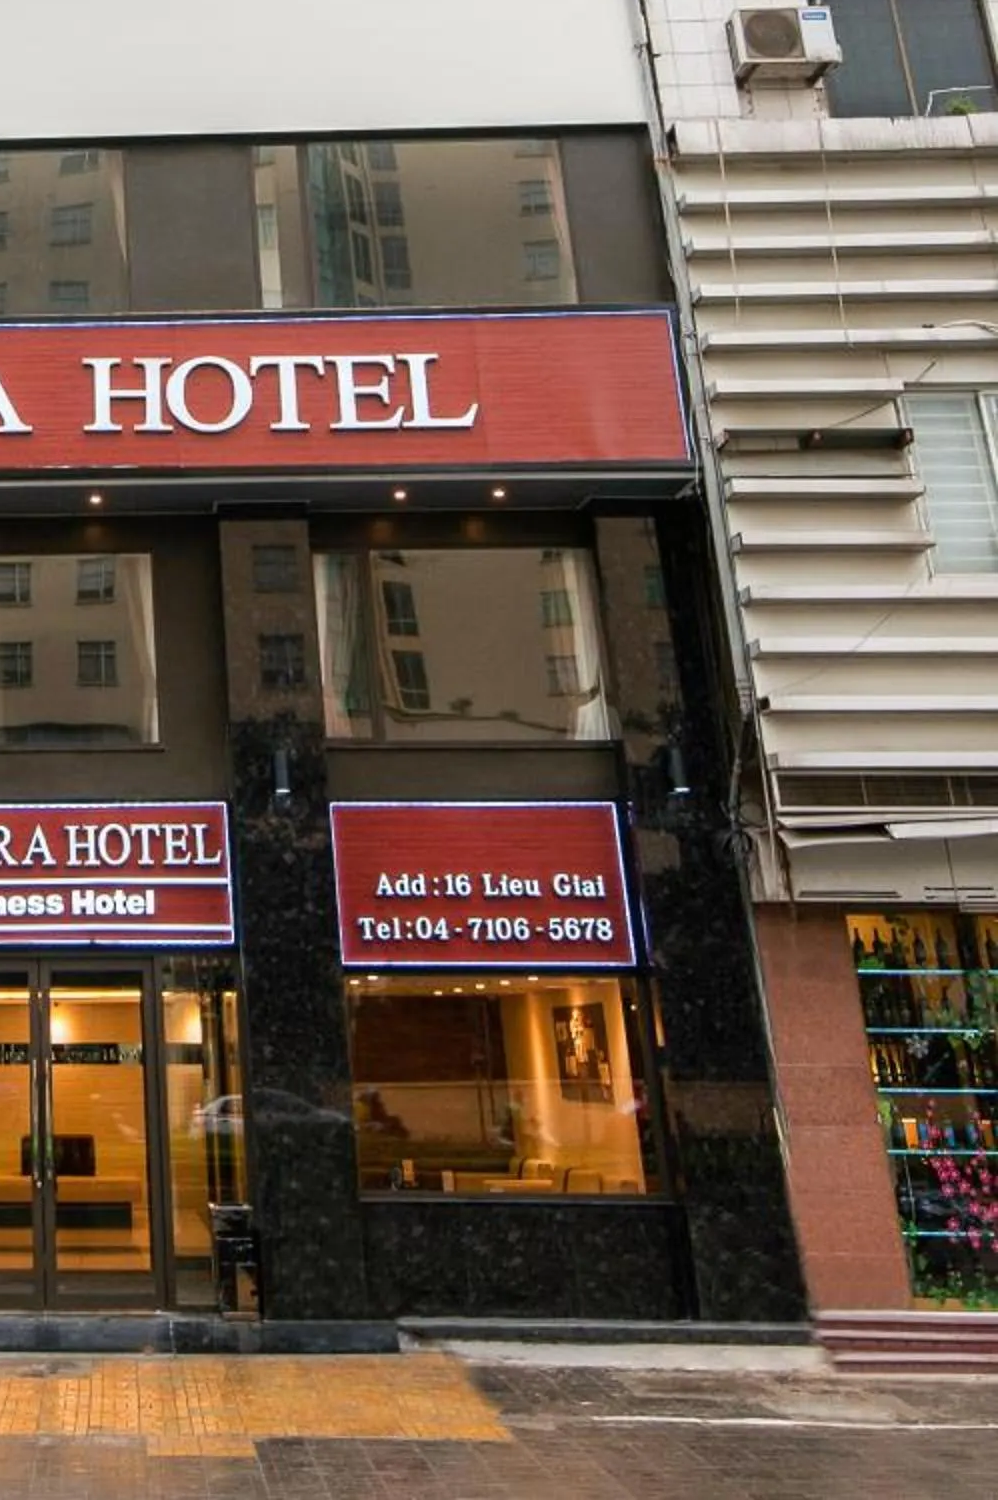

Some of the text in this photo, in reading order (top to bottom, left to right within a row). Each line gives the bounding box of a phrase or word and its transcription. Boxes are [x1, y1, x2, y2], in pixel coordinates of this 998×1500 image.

[82, 352, 479, 434] HOTEL
[65, 823, 222, 866] HOTEL
[71, 889, 155, 916] Hotel
[482, 873, 542, 897] Lieu
[553, 873, 606, 897] Giai
